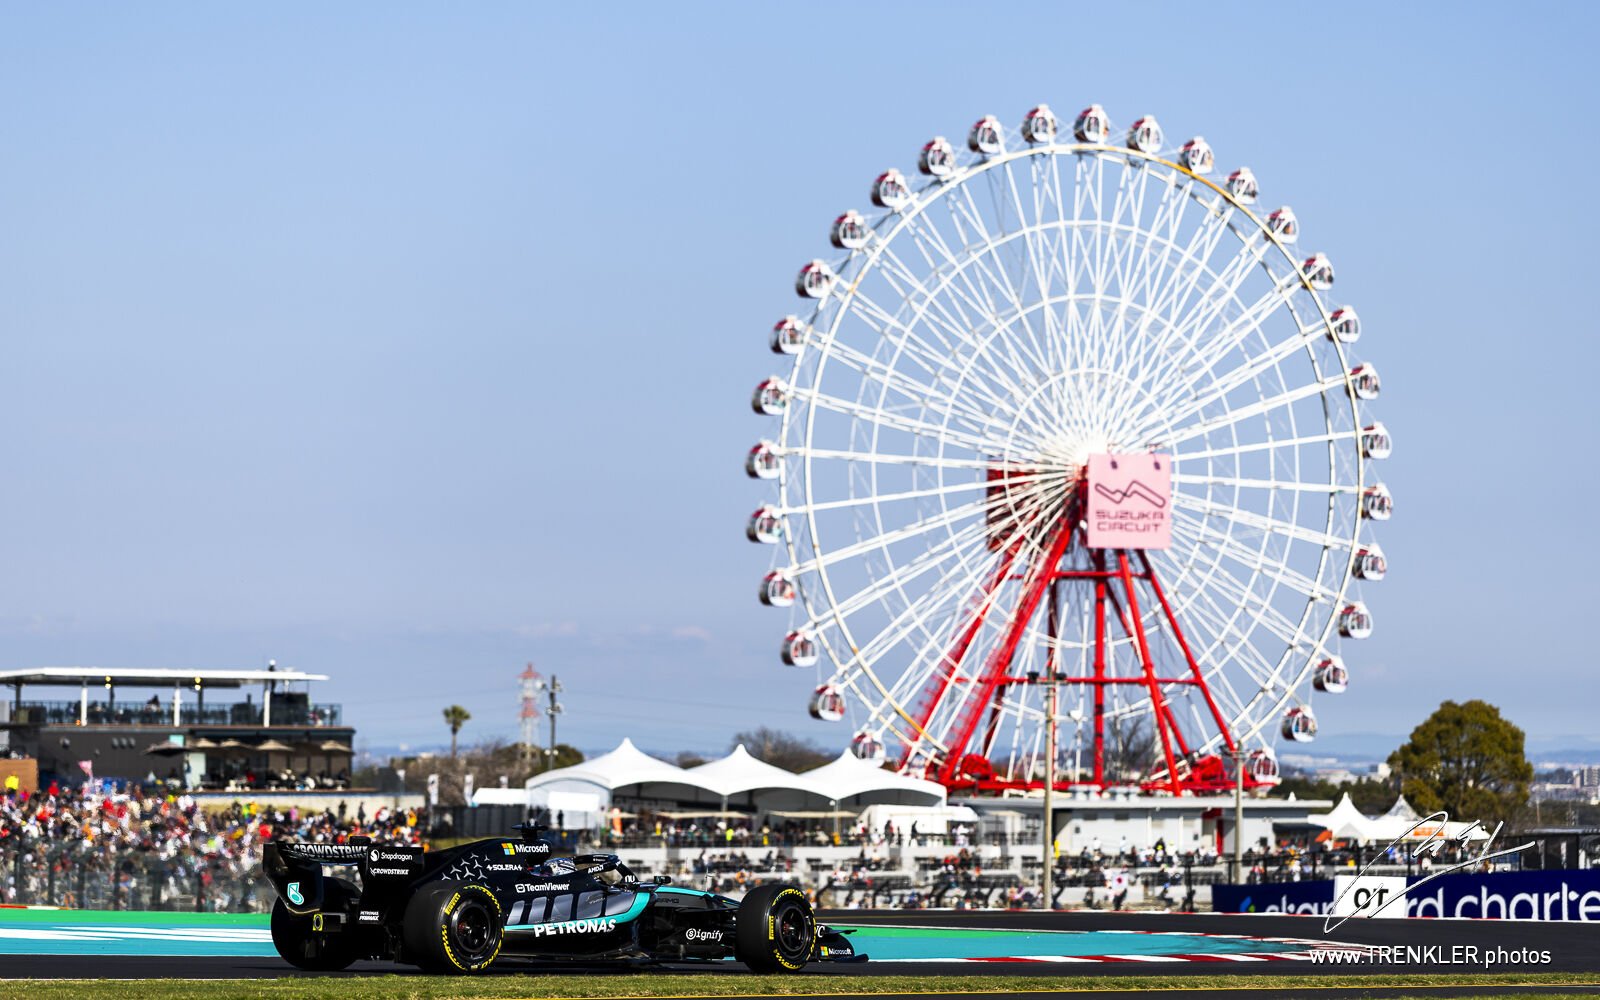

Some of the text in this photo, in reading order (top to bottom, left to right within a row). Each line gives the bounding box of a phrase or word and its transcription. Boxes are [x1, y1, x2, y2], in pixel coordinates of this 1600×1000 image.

[1096, 510, 1164, 520] SUZUKA
[1097, 521, 1161, 532] CIRCUIT
[515, 843, 549, 853] Microsoft
[381, 852, 413, 861] Snapdragon
[525, 883, 570, 892] TeamViewer
[533, 919, 616, 937] PETRONAS
[828, 947, 852, 955] Microsoft
